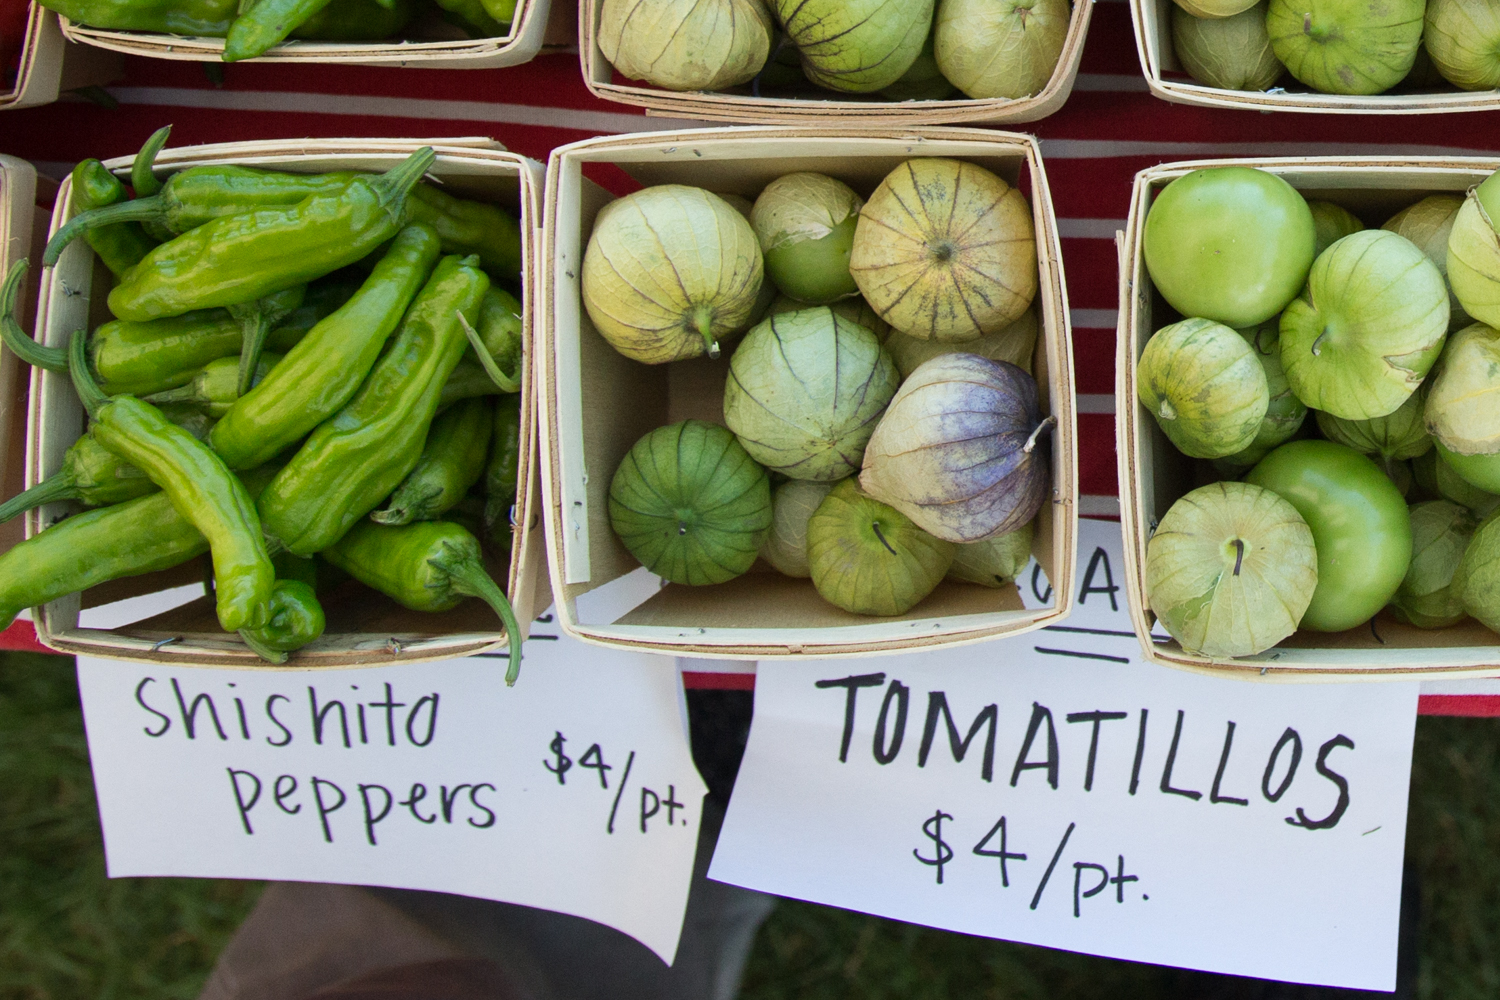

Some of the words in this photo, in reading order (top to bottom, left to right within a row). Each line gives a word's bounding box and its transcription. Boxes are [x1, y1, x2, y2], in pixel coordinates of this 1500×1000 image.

[542, 730, 689, 835] $4/pt.
[815, 671, 1356, 831] TOMATILLOS
[226, 766, 497, 847] peppers
[912, 808, 1150, 919] $4/pt.
